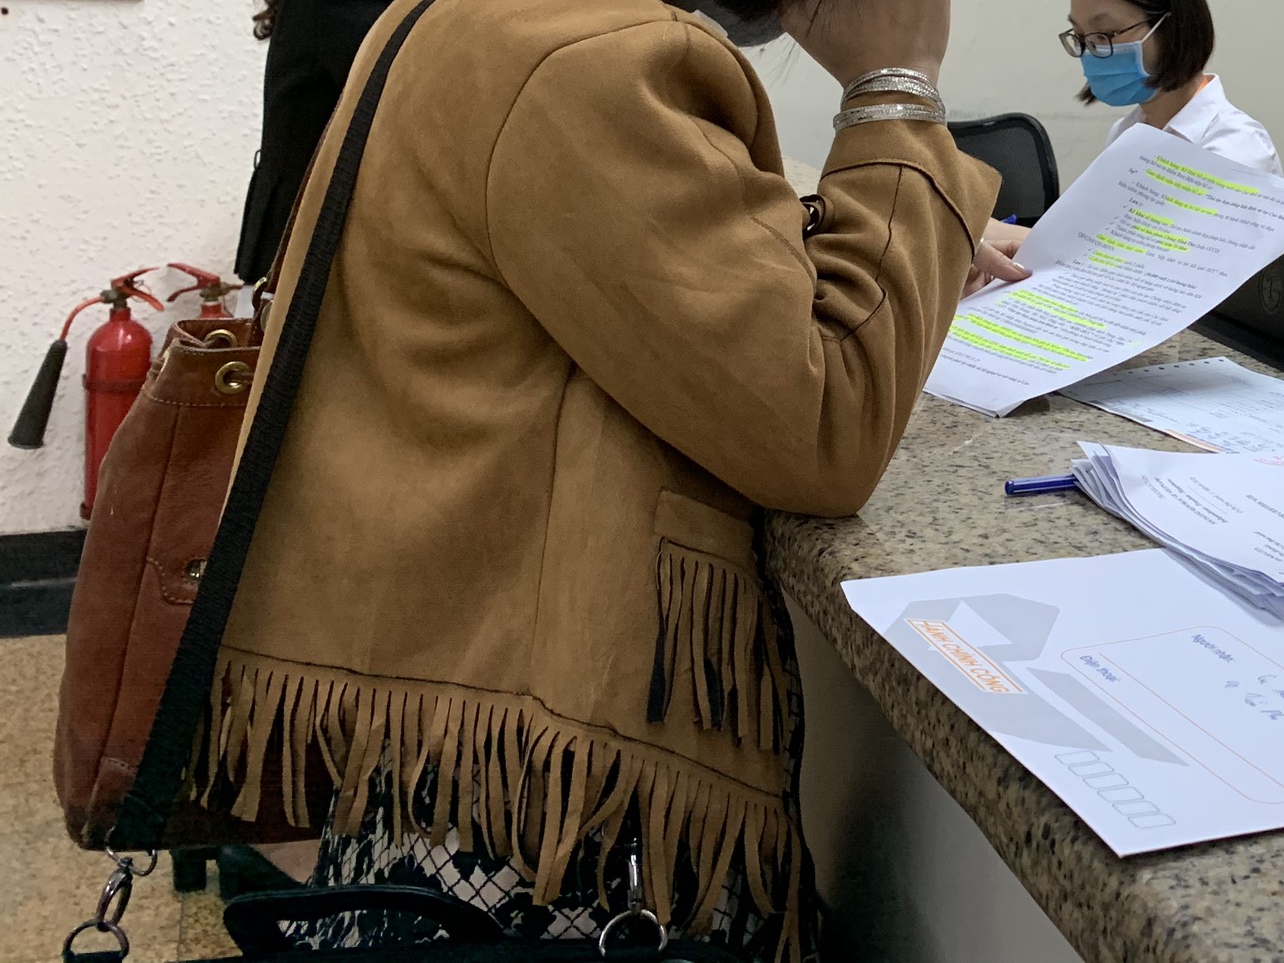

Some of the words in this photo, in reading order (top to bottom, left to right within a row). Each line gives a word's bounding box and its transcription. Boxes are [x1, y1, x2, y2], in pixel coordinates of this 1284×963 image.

[920, 621, 950, 644] HÀNH
[942, 641, 983, 668] CHÍNH
[970, 667, 1010, 693] CÔNG
